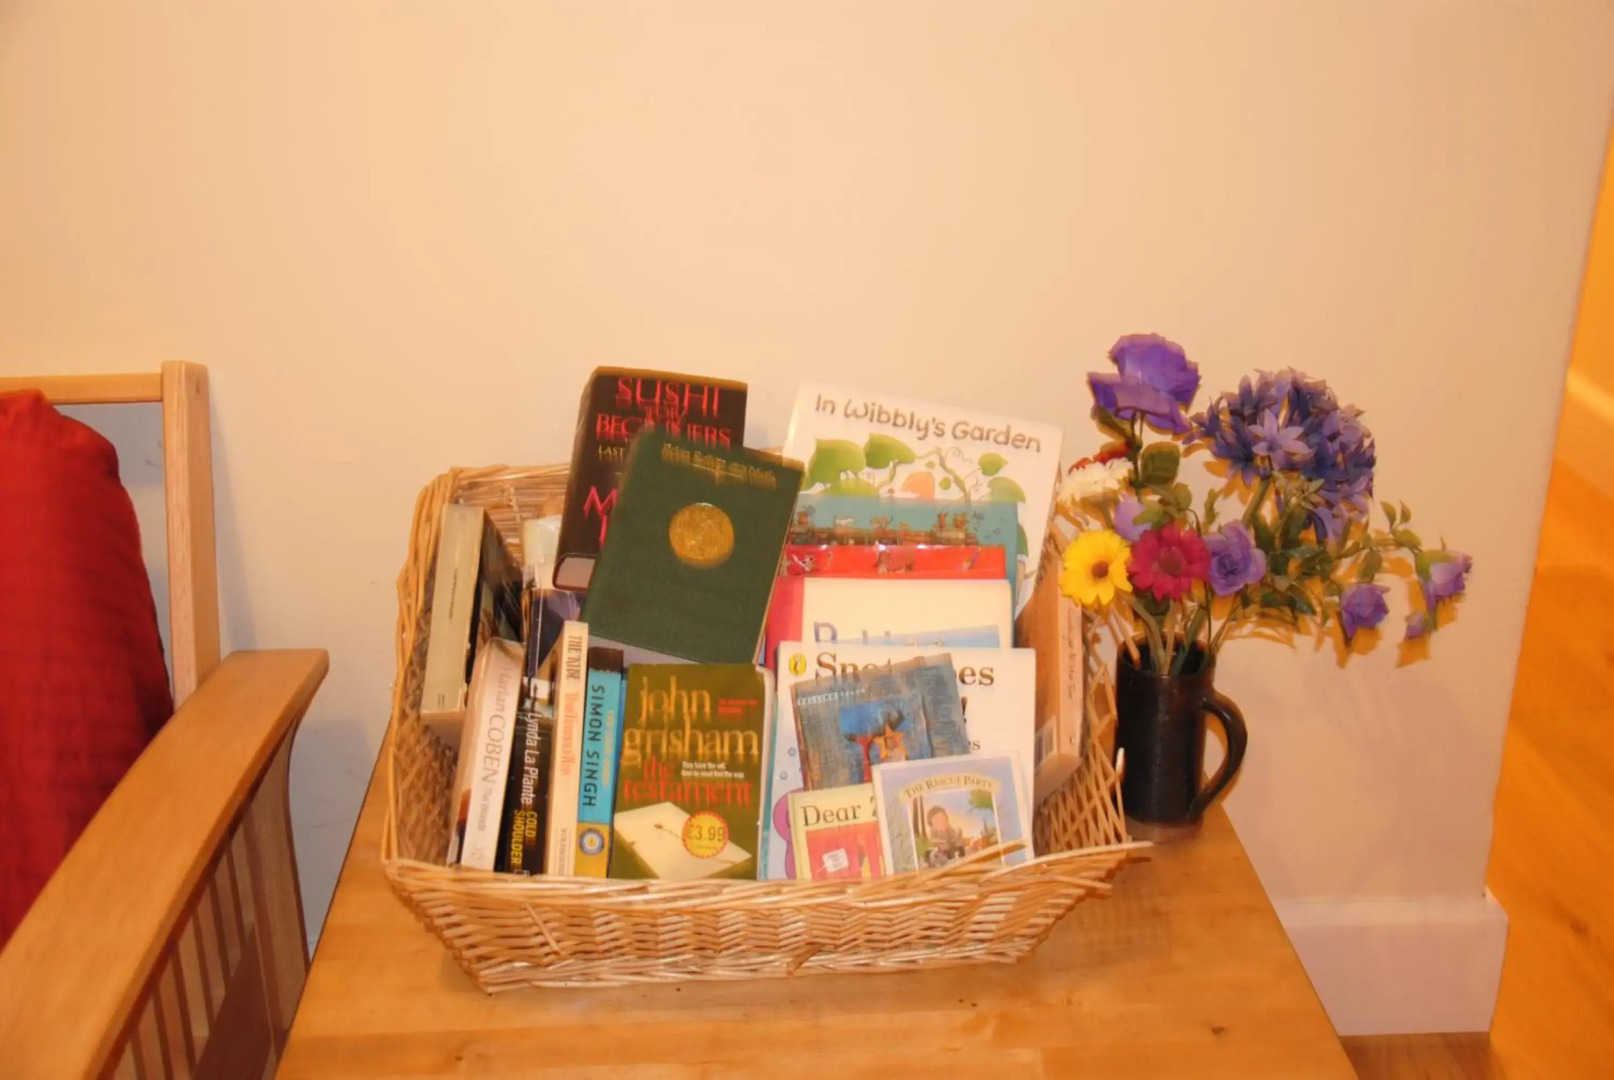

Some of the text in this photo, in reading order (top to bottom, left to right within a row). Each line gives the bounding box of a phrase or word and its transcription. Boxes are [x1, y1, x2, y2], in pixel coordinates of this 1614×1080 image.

[616, 377, 720, 418] SUSHI
[814, 393, 1042, 454] In Wibbly's Garden
[639, 676, 711, 725] john
[483, 714, 505, 784] COBEN
[521, 710, 543, 805] Lynda La Plante
[584, 685, 605, 807] SIMON SINGH
[620, 708, 759, 768] grisham
[624, 779, 753, 808] testament
[963, 775, 993, 790] PARTY
[511, 810, 526, 865] SHOULDER
[525, 811, 538, 837] COLD
[801, 802, 862, 828] Dear
